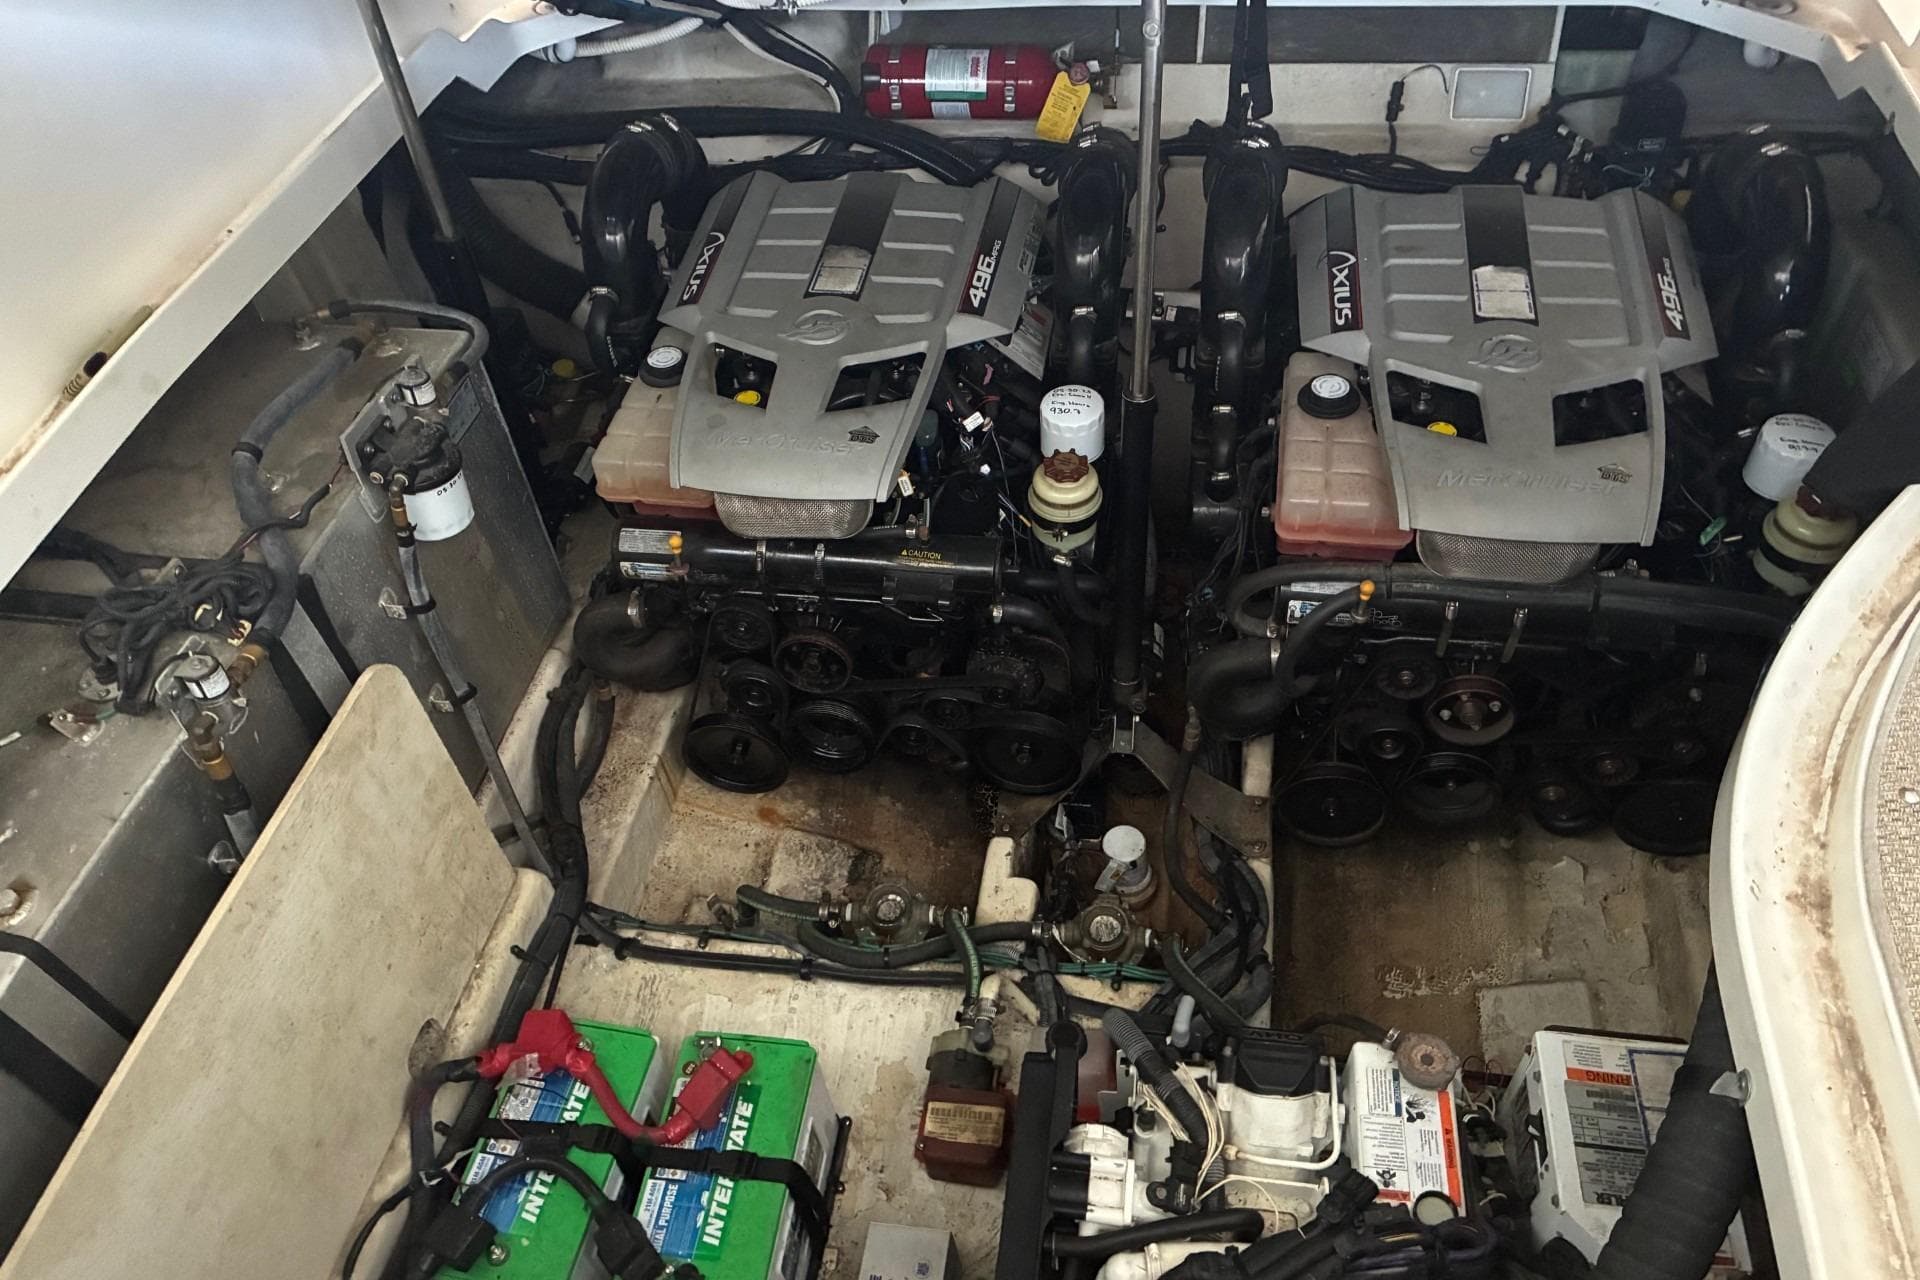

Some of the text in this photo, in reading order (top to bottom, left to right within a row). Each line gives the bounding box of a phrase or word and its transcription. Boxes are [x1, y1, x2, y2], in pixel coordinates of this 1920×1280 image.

[683, 231, 725, 301] AXIUS
[969, 254, 996, 308] 496
[1328, 250, 1357, 326] AXIUS
[1657, 273, 1684, 331] 496
[908, 549, 942, 560] CAUTION
[659, 1183, 679, 1227] PURPOSE
